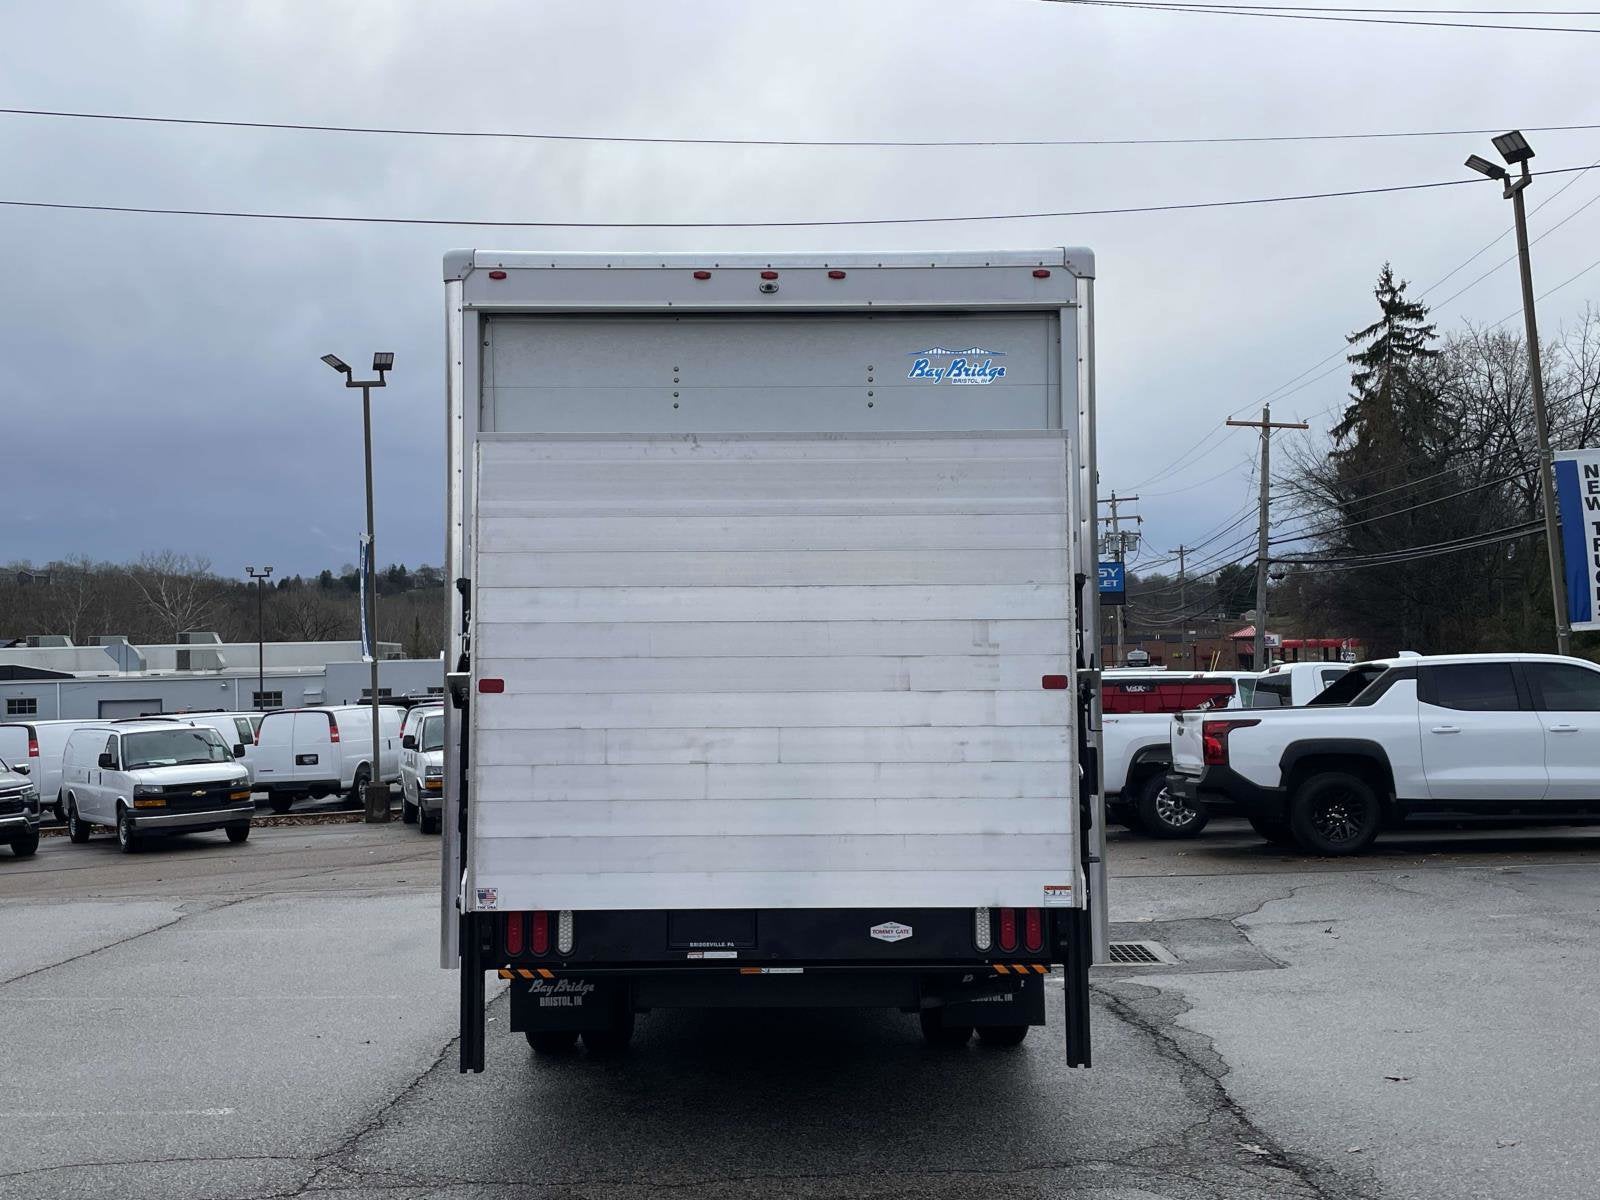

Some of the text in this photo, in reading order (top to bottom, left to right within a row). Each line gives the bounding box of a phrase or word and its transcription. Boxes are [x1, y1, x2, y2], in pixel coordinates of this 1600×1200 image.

[908, 358, 1006, 384] Bay Bridge
[528, 979, 595, 996] Bay Bridge
[573, 995, 583, 1006] IN
